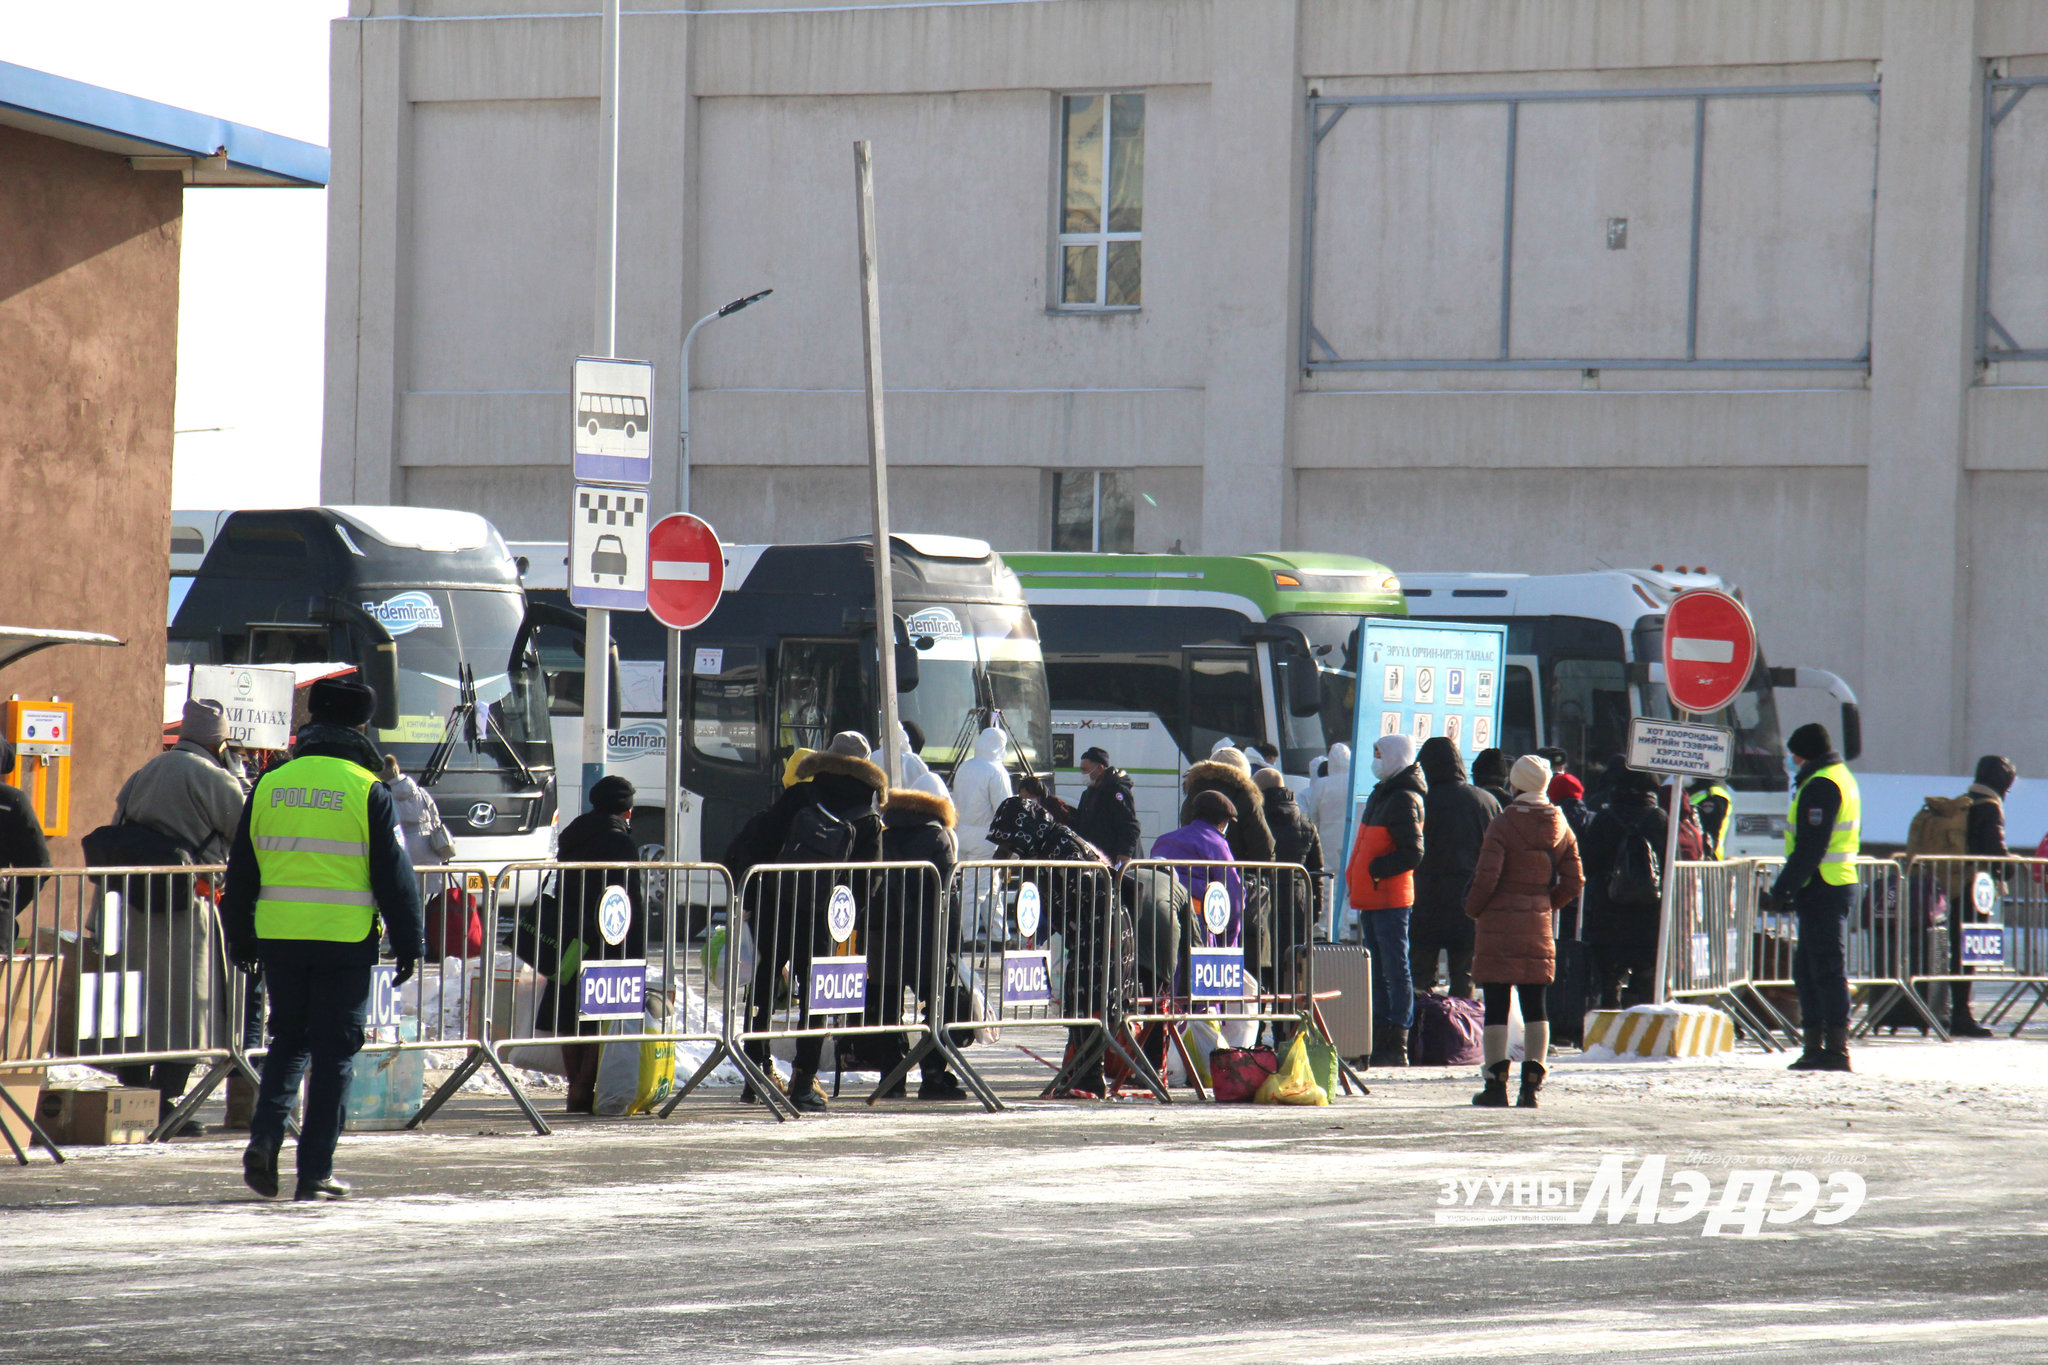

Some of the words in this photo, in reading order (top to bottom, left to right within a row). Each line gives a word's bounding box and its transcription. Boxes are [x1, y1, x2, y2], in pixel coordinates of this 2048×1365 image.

[905, 616, 961, 633] demTrans
[246, 709, 287, 726] ТАТАХ
[607, 730, 666, 748] demTran
[1638, 736, 1680, 747] НИЙТИЙН
[1682, 741, 1725, 752] ТЭЭВРИЙН
[1647, 727, 1664, 736] ХОТ
[1665, 729, 1719, 742] ХООРОНДЫН
[1656, 748, 1704, 760] ХЭРЭГСЭЛД
[271, 787, 345, 811] POLICE
[1964, 935, 2002, 955] POLICE
[1007, 966, 1048, 993] POLICE
[1195, 963, 1241, 989] POLICE
[585, 976, 642, 1005] POLICE
[815, 973, 864, 1000] POLICE
[366, 971, 402, 1025] ICE
